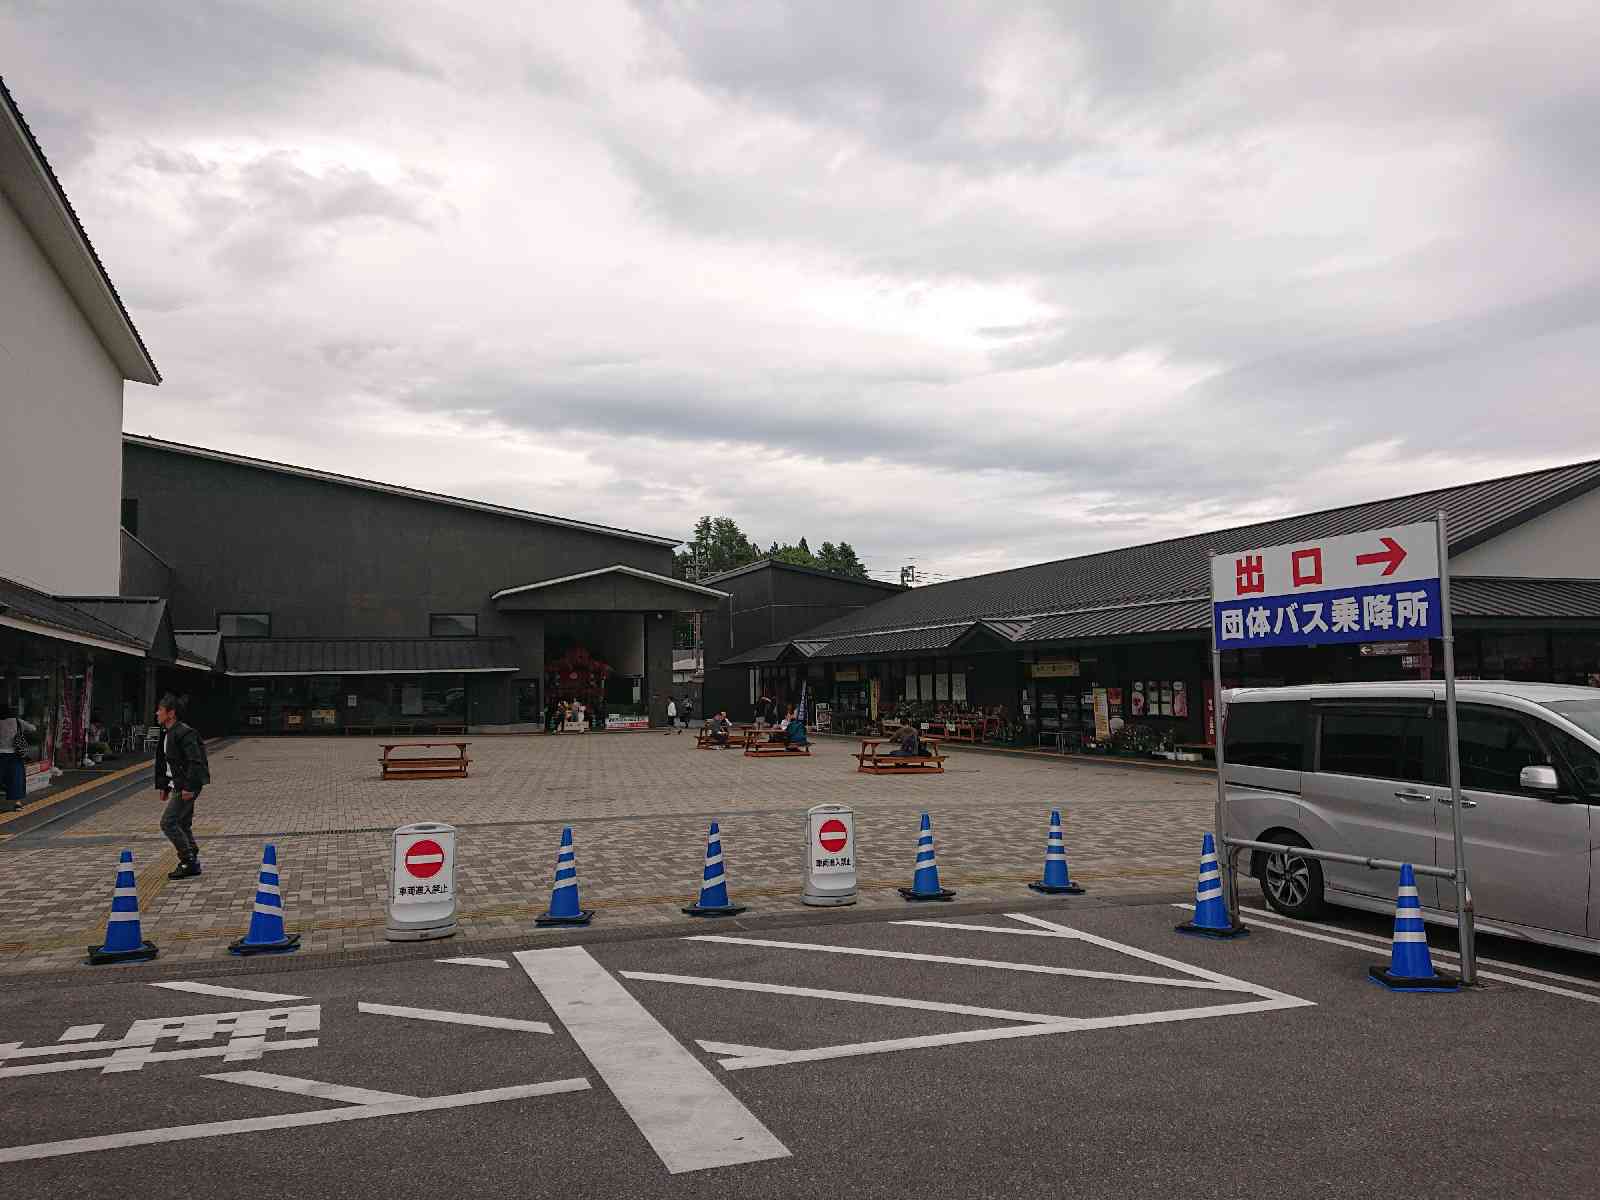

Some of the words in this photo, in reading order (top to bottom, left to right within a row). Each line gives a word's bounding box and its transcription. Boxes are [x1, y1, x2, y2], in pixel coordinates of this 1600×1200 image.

[1236, 547, 1323, 595] 出口
[1221, 590, 1429, 641] 団体バス乗降所
